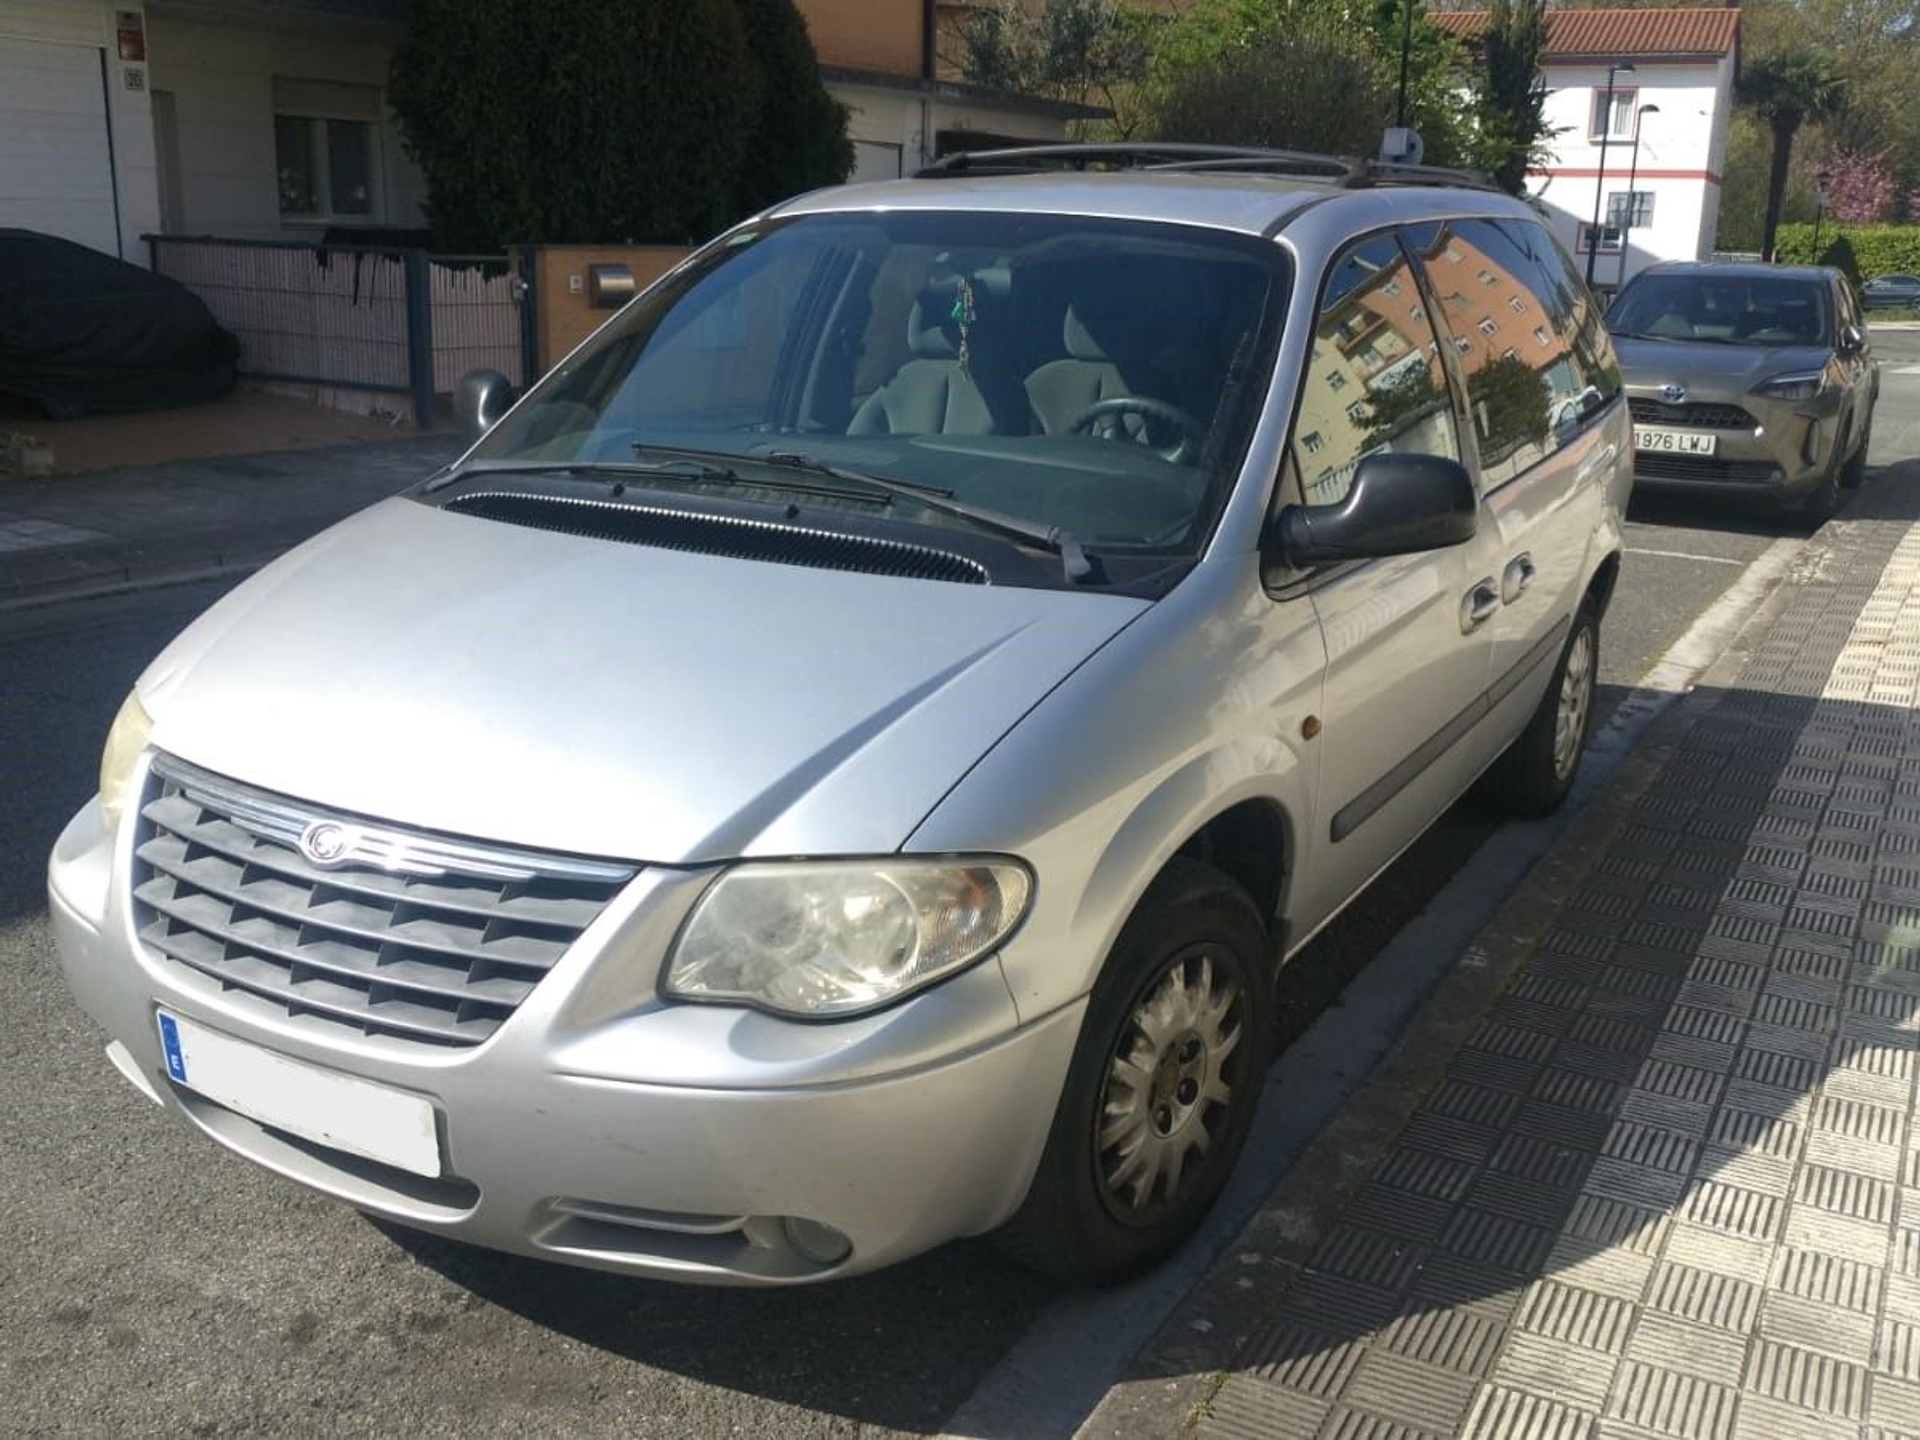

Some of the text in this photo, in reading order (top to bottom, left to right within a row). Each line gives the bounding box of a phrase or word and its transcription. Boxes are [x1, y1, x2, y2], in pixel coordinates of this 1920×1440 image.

[1635, 432, 1711, 452] 1976 LWJ
[171, 1054, 181, 1071] E
